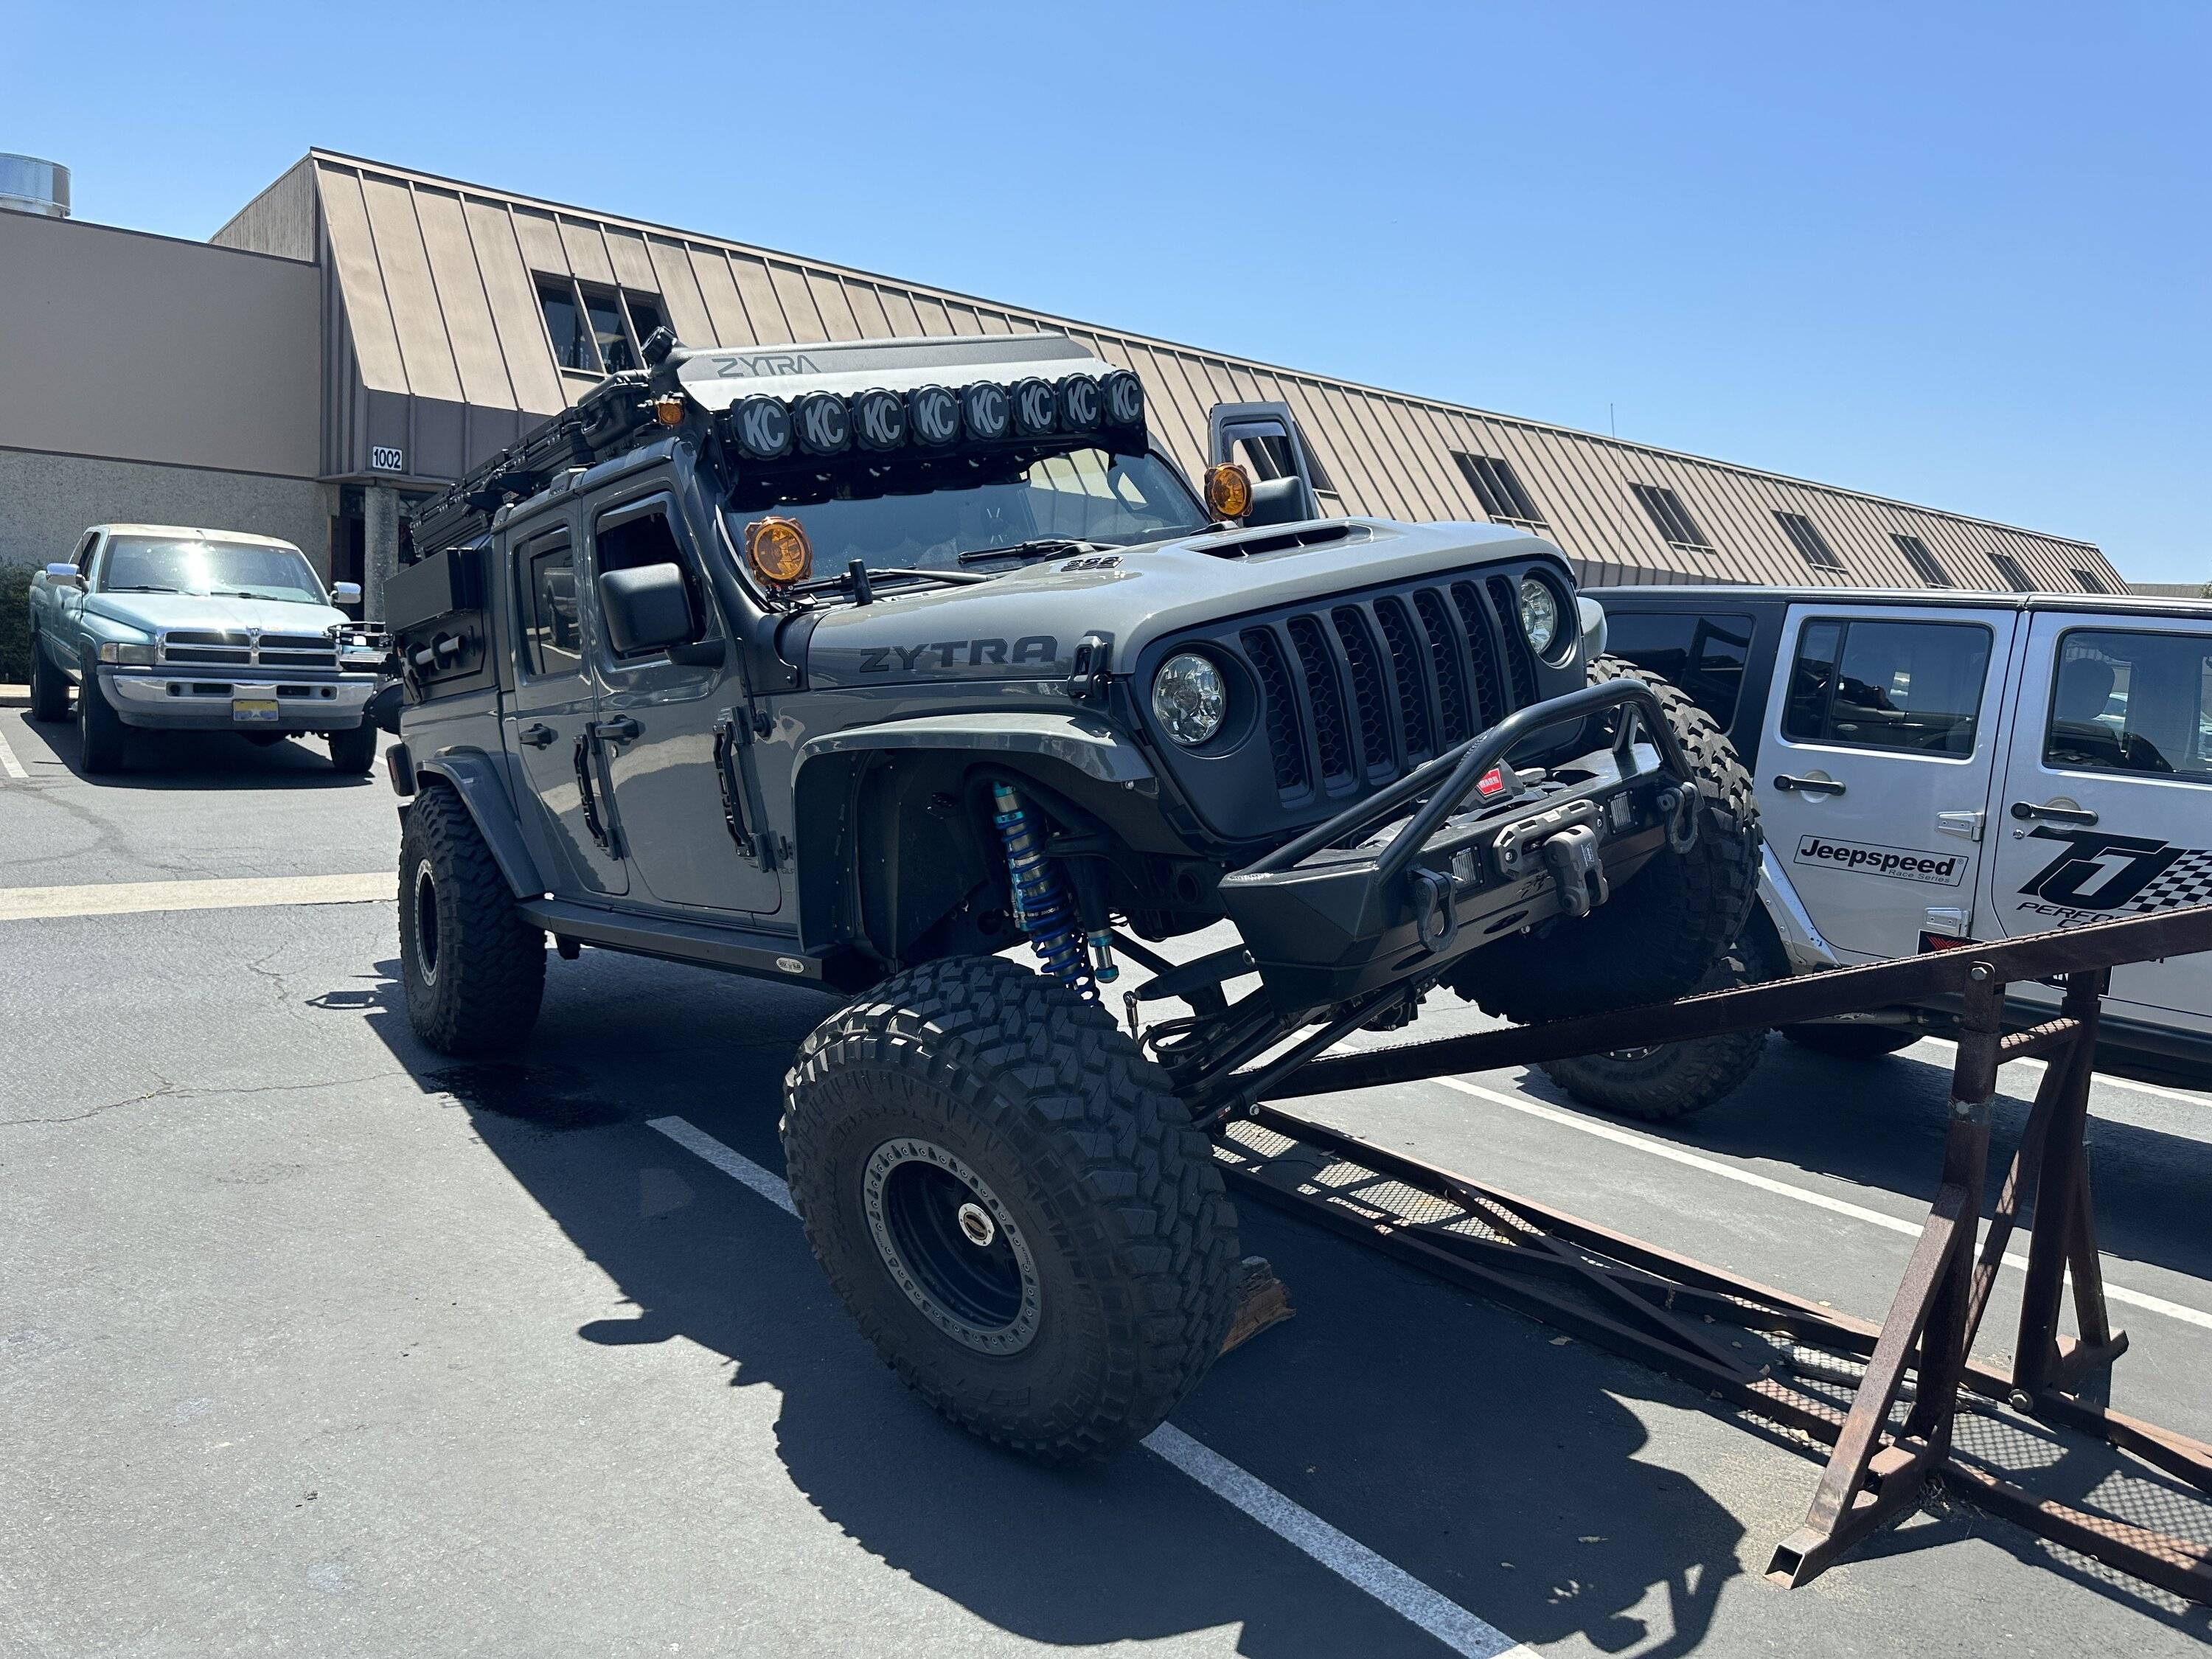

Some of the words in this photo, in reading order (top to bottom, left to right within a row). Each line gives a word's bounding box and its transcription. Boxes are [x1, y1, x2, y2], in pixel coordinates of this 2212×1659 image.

[712, 355, 821, 378] ZYTRA
[863, 396, 900, 442] KC
[919, 392, 953, 438] KC
[972, 389, 1004, 433] KC
[1021, 385, 1051, 428] KC
[1068, 380, 1096, 423] KC
[1112, 378, 1139, 420] KC
[743, 403, 784, 451] KC
[805, 399, 844, 447] KC
[375, 448, 400, 468] 1002
[859, 635, 1058, 672] ZYTRA
[1888, 869, 1914, 877] Race
[1917, 873, 1951, 883] Series
